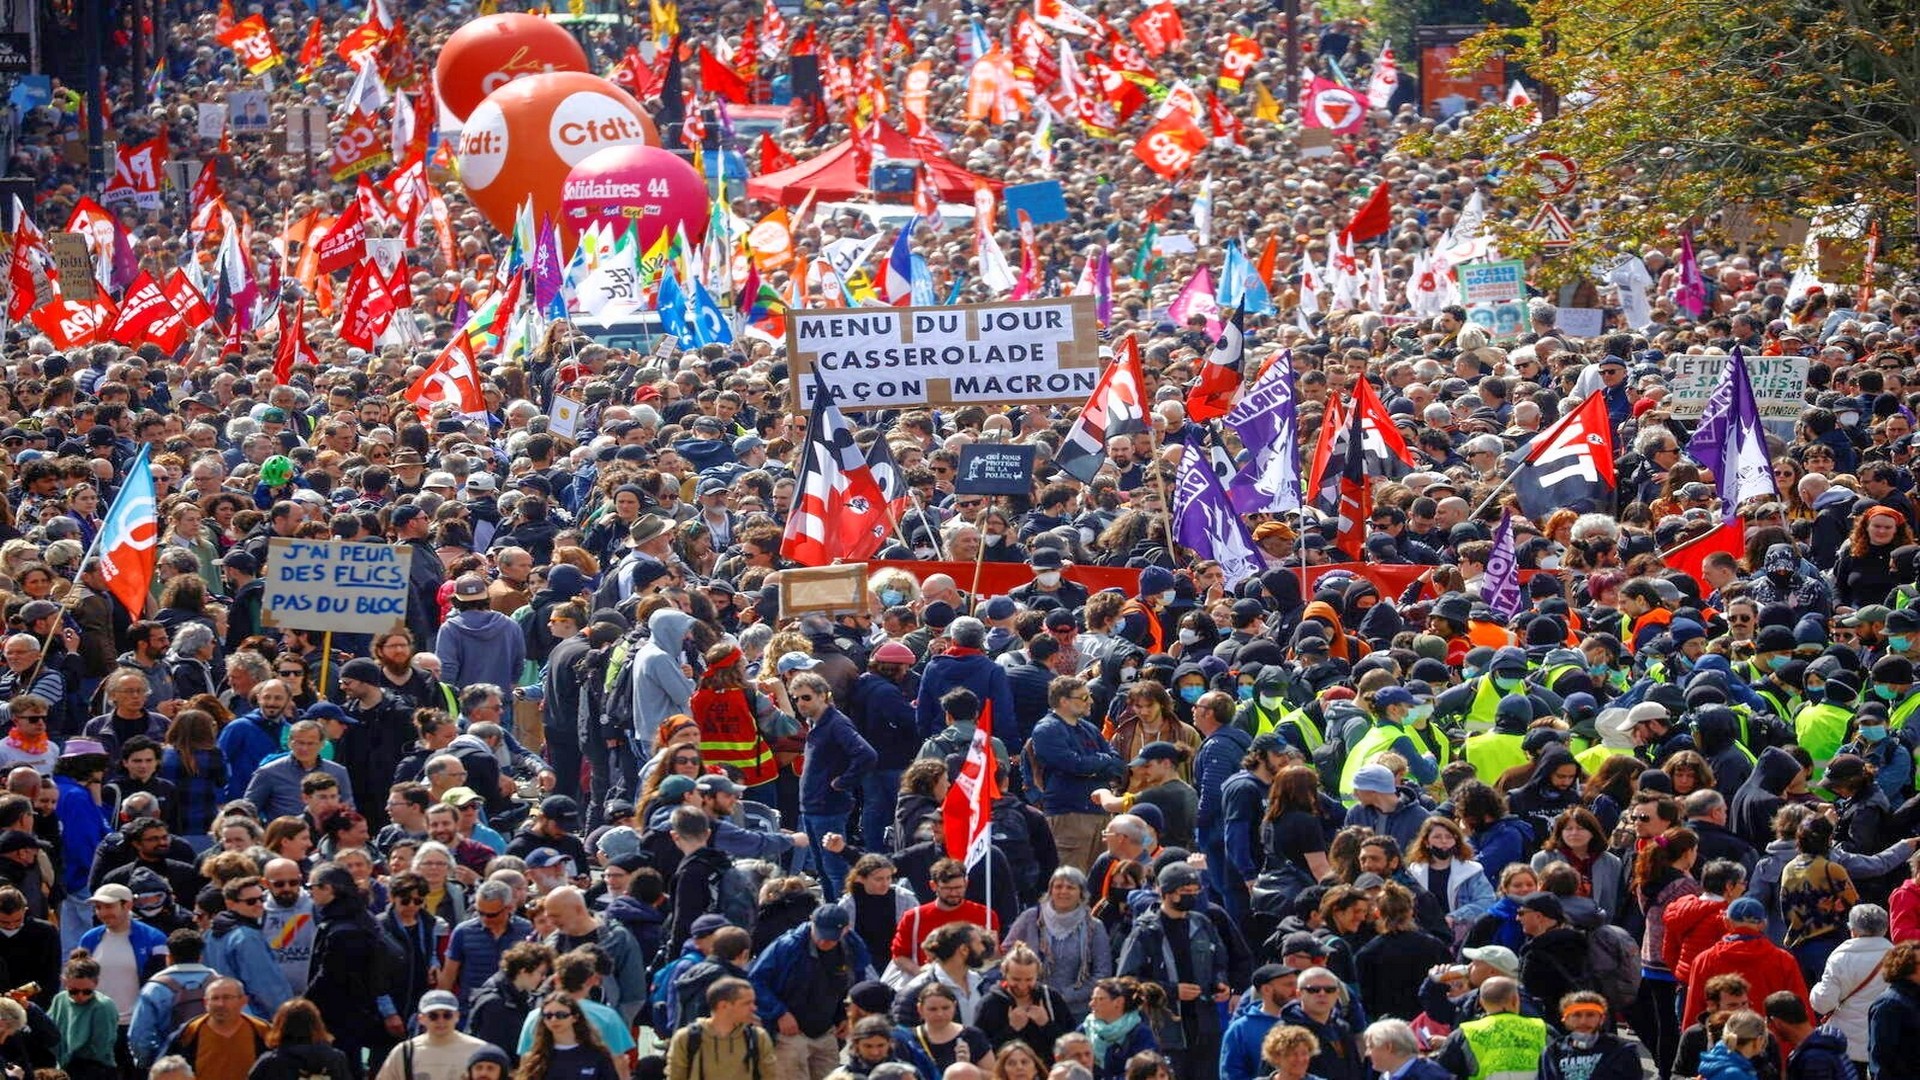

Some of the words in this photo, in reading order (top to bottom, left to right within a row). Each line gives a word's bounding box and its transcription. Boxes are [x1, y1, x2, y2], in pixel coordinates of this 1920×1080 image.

[558, 117, 643, 145] Cfdt:
[1149, 133, 1190, 169] cgt
[564, 179, 641, 200] Solidaires
[647, 178, 670, 197] 44
[1467, 274, 1516, 285] SOCIALE
[1476, 267, 1515, 276] CASSE
[800, 315, 892, 338] MENU
[916, 314, 958, 333] DU
[981, 310, 1064, 332] JOUR
[821, 343, 1044, 370] CASSEROLADE
[1684, 358, 1793, 374] ÉTUANTS
[954, 371, 1096, 395] MACRON
[340, 545, 394, 562] PEUR
[281, 564, 326, 582] DES
[272, 594, 312, 610] PAS
[316, 595, 349, 613] DU
[356, 595, 404, 614] BLOC
